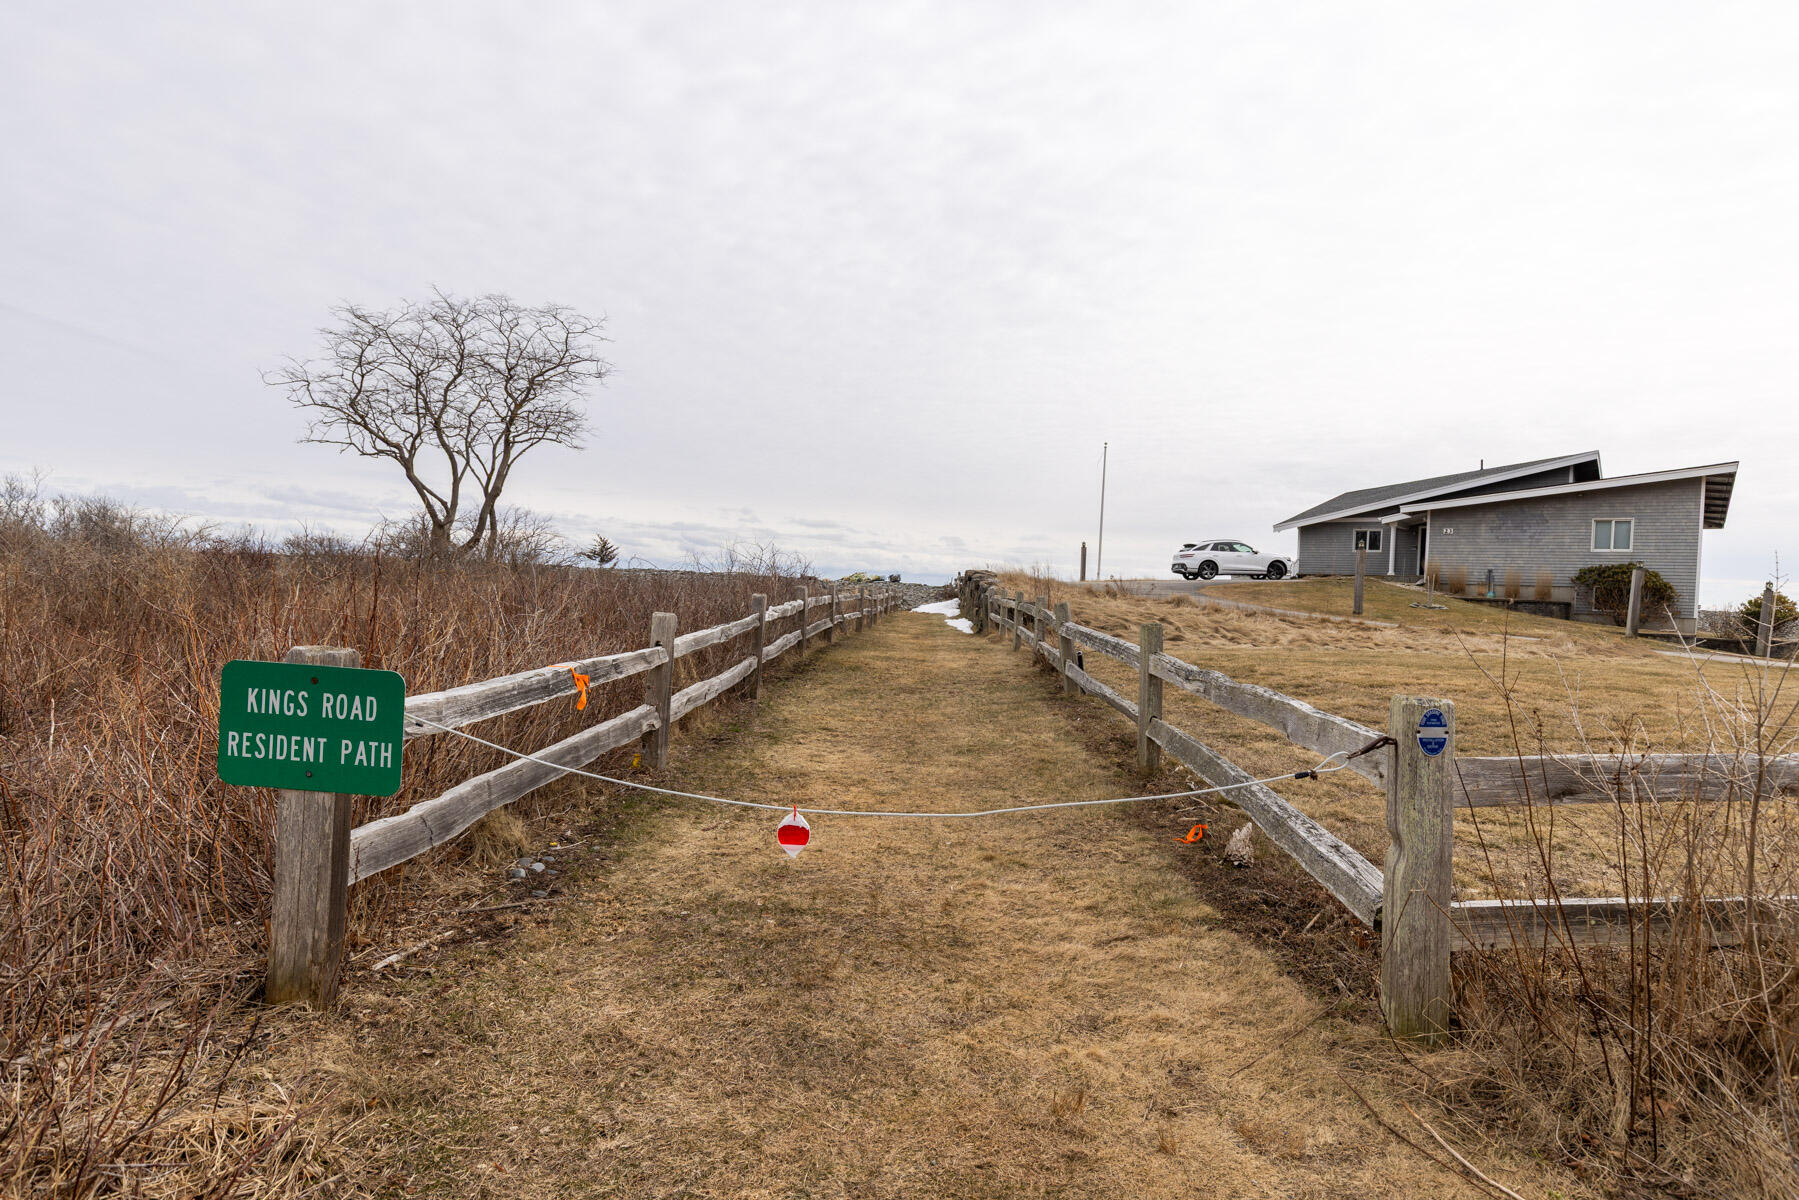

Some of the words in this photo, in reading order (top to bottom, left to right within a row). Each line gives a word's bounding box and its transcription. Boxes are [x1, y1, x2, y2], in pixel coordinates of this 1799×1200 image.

[247, 687, 309, 717] KINGS
[321, 692, 377, 722] ROAD
[227, 730, 327, 763] RESIDENT
[340, 739, 392, 768] PATH
